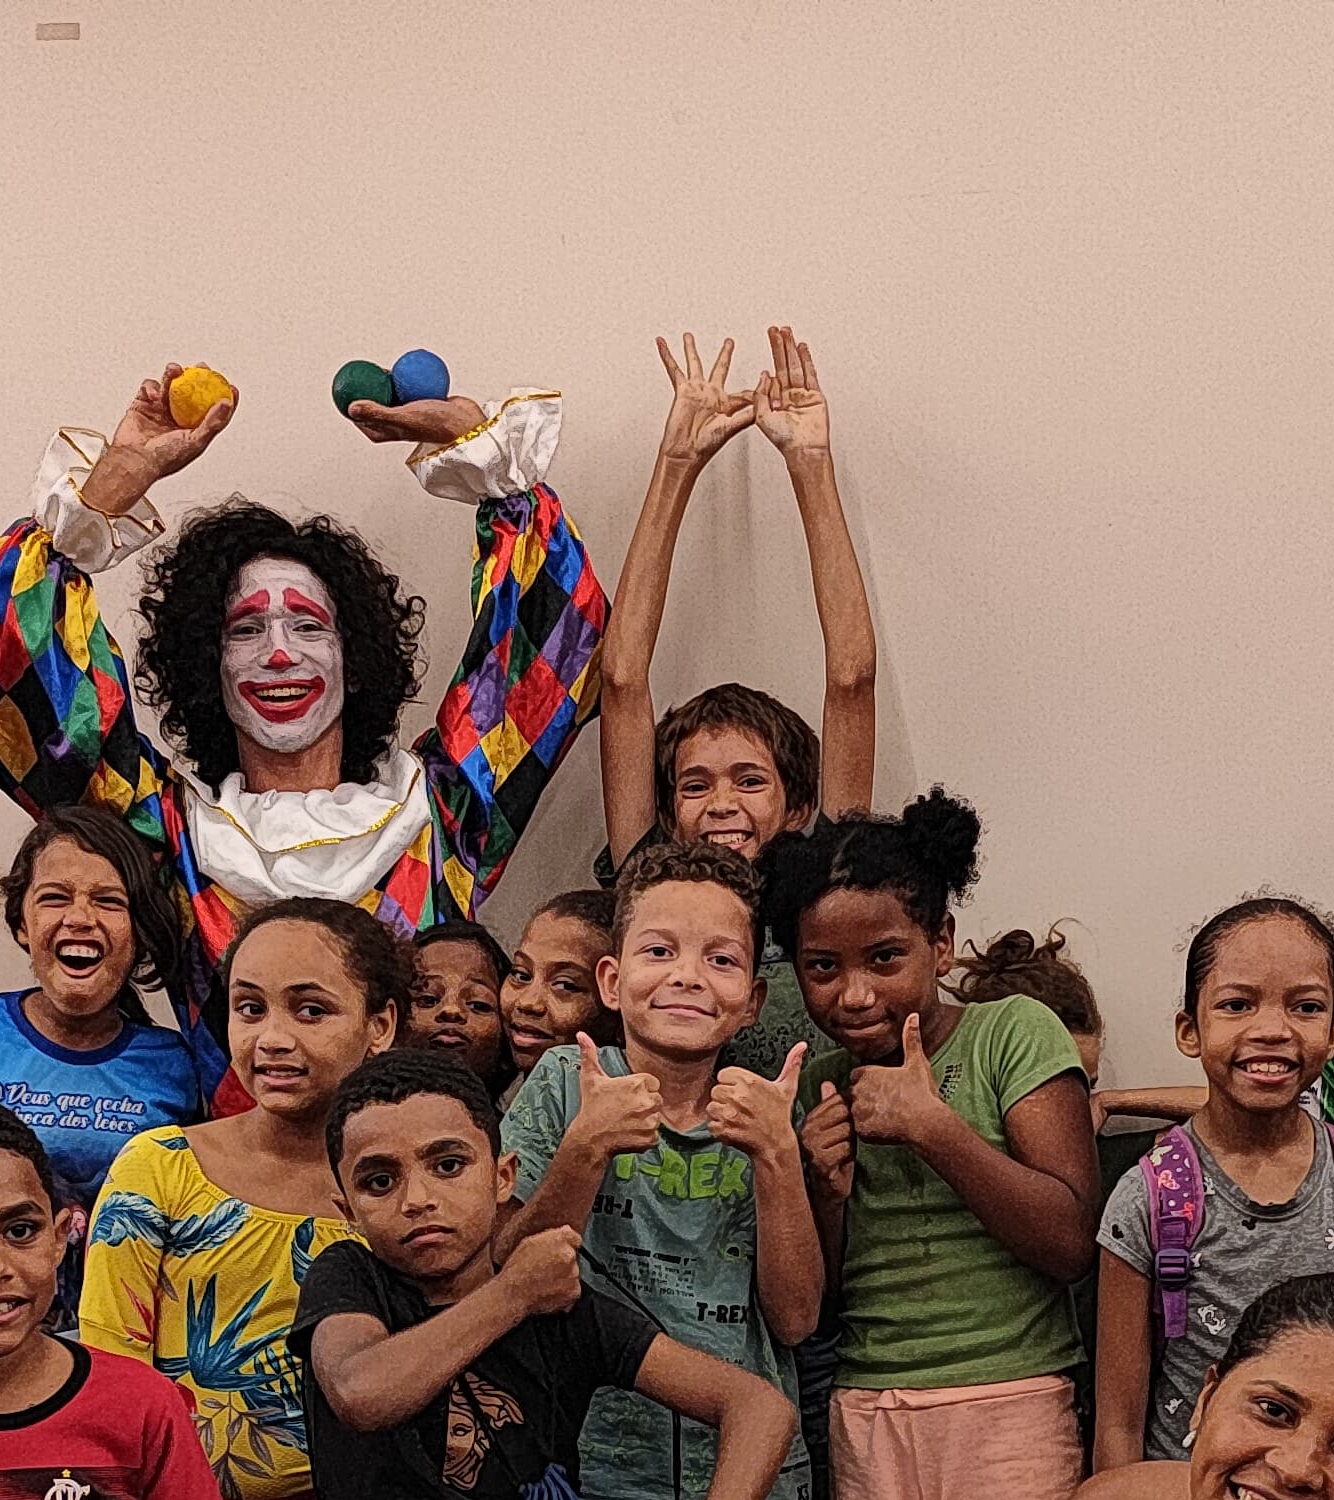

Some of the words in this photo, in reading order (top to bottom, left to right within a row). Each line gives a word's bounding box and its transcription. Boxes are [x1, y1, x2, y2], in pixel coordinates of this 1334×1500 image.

[6, 1083, 52, 1106] Deus
[56, 1094, 92, 1111] que
[94, 1095, 145, 1114] fecha
[58, 1110, 90, 1128] dos
